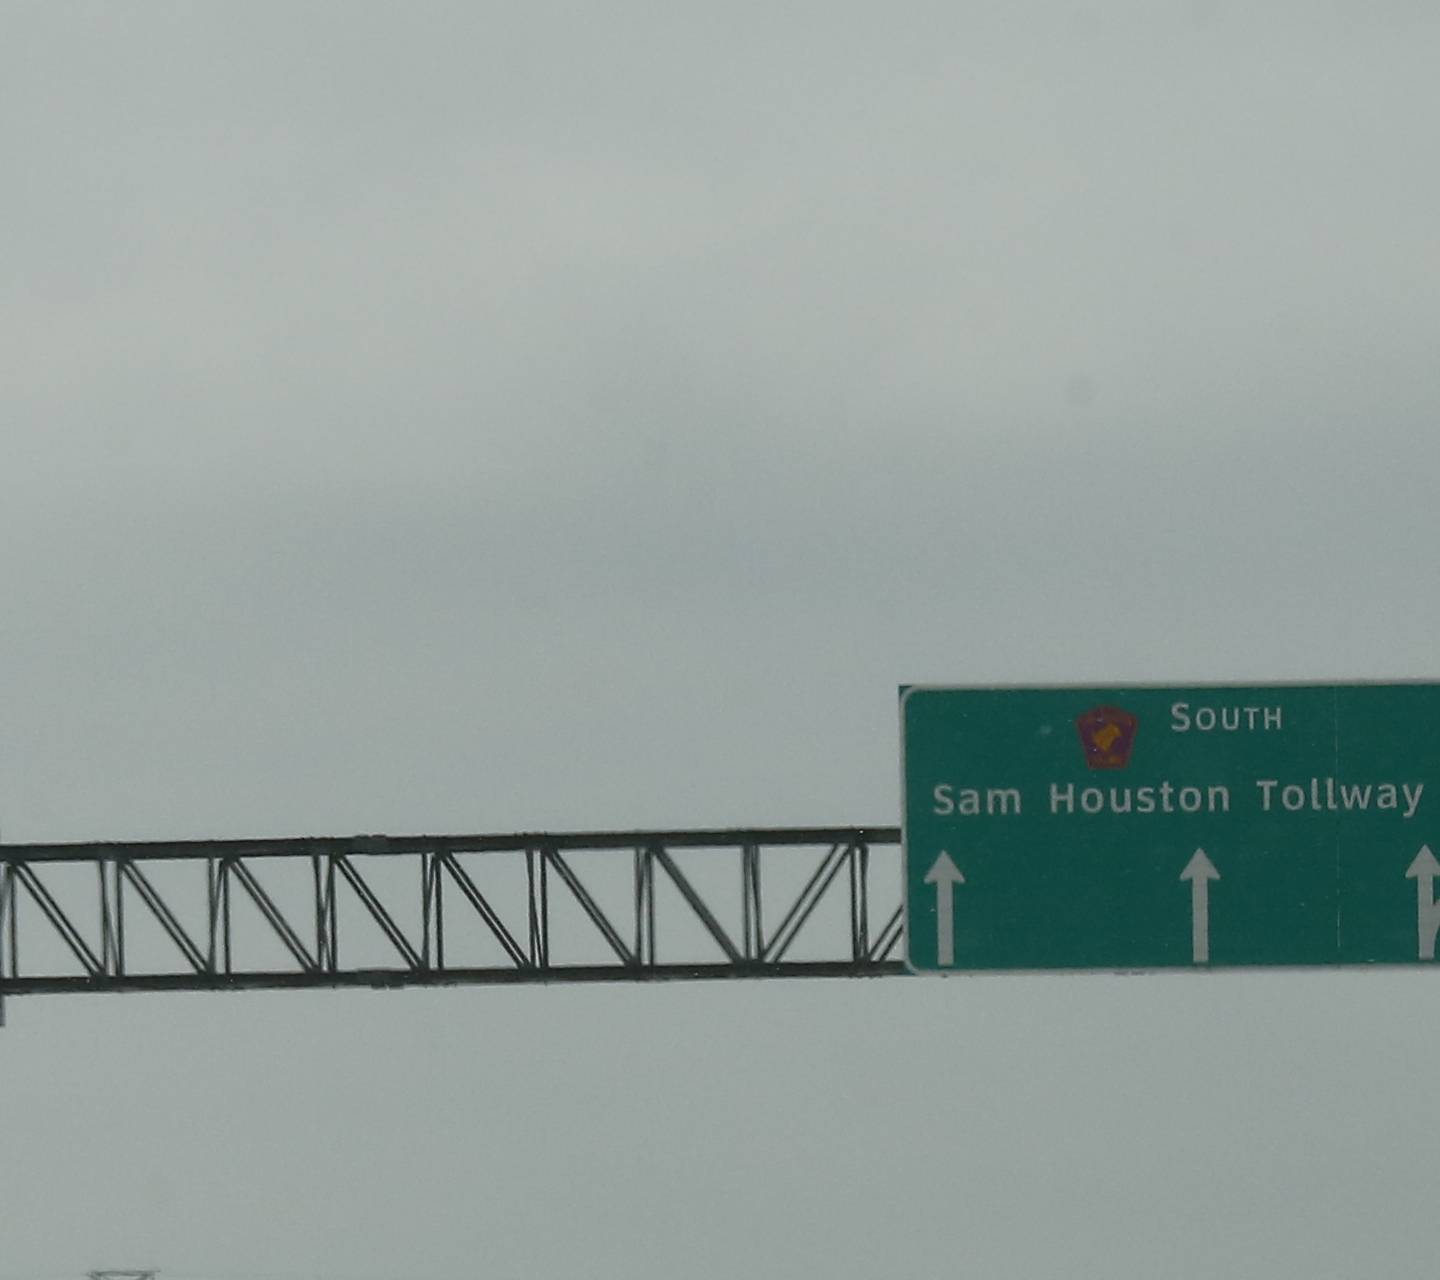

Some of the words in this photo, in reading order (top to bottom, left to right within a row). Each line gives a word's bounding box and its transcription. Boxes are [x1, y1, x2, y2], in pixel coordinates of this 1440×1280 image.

[1169, 702, 1284, 733] SOUTH
[933, 783, 1023, 816] Sam
[1050, 779, 1231, 815] Houston
[1256, 776, 1425, 820] Tollway
